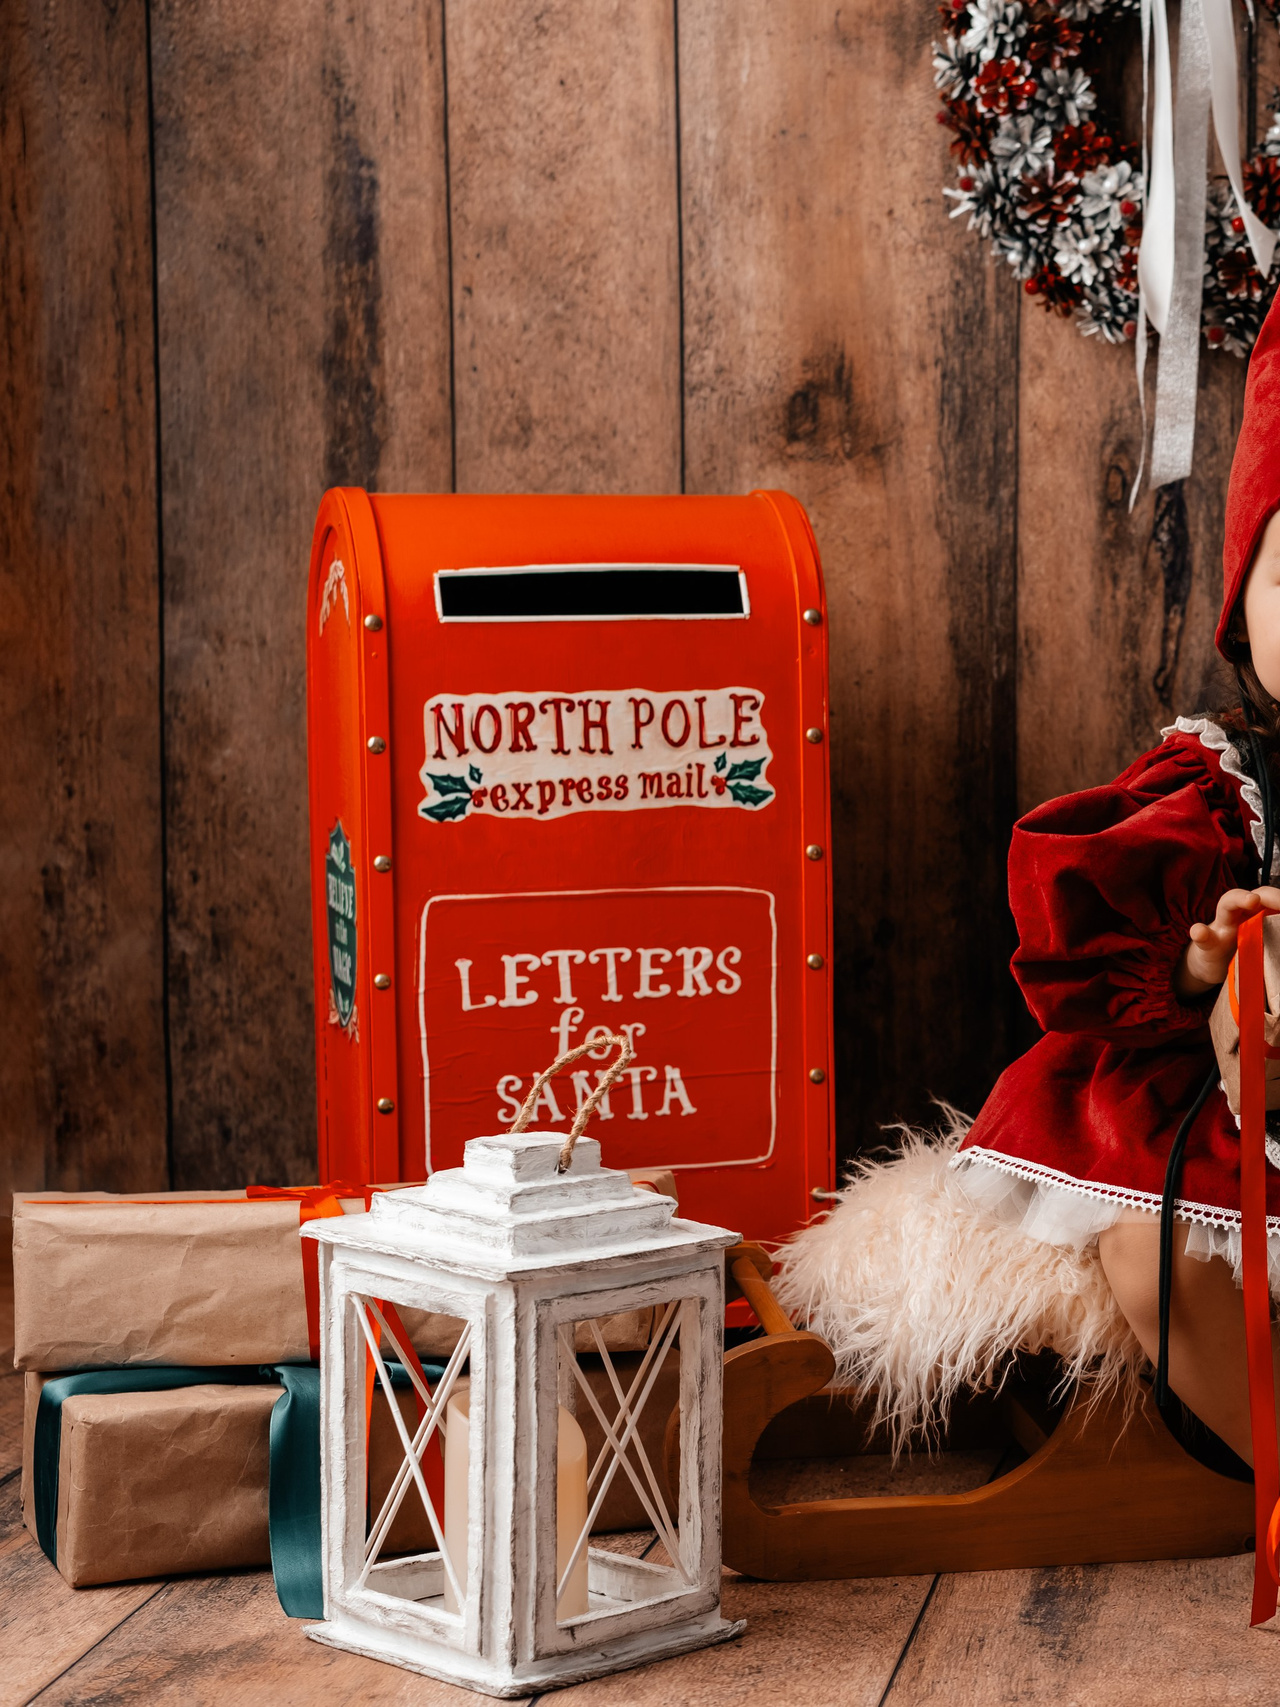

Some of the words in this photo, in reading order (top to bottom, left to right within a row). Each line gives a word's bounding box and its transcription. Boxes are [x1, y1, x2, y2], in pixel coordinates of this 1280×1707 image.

[429, 696, 615, 760] NORTH
[631, 692, 762, 750] POLE
[489, 772, 629, 815] express
[638, 763, 711, 799] mail
[455, 946, 742, 1012] LETTERS
[550, 1007, 647, 1062] for
[496, 1065, 698, 1124] SANTA
